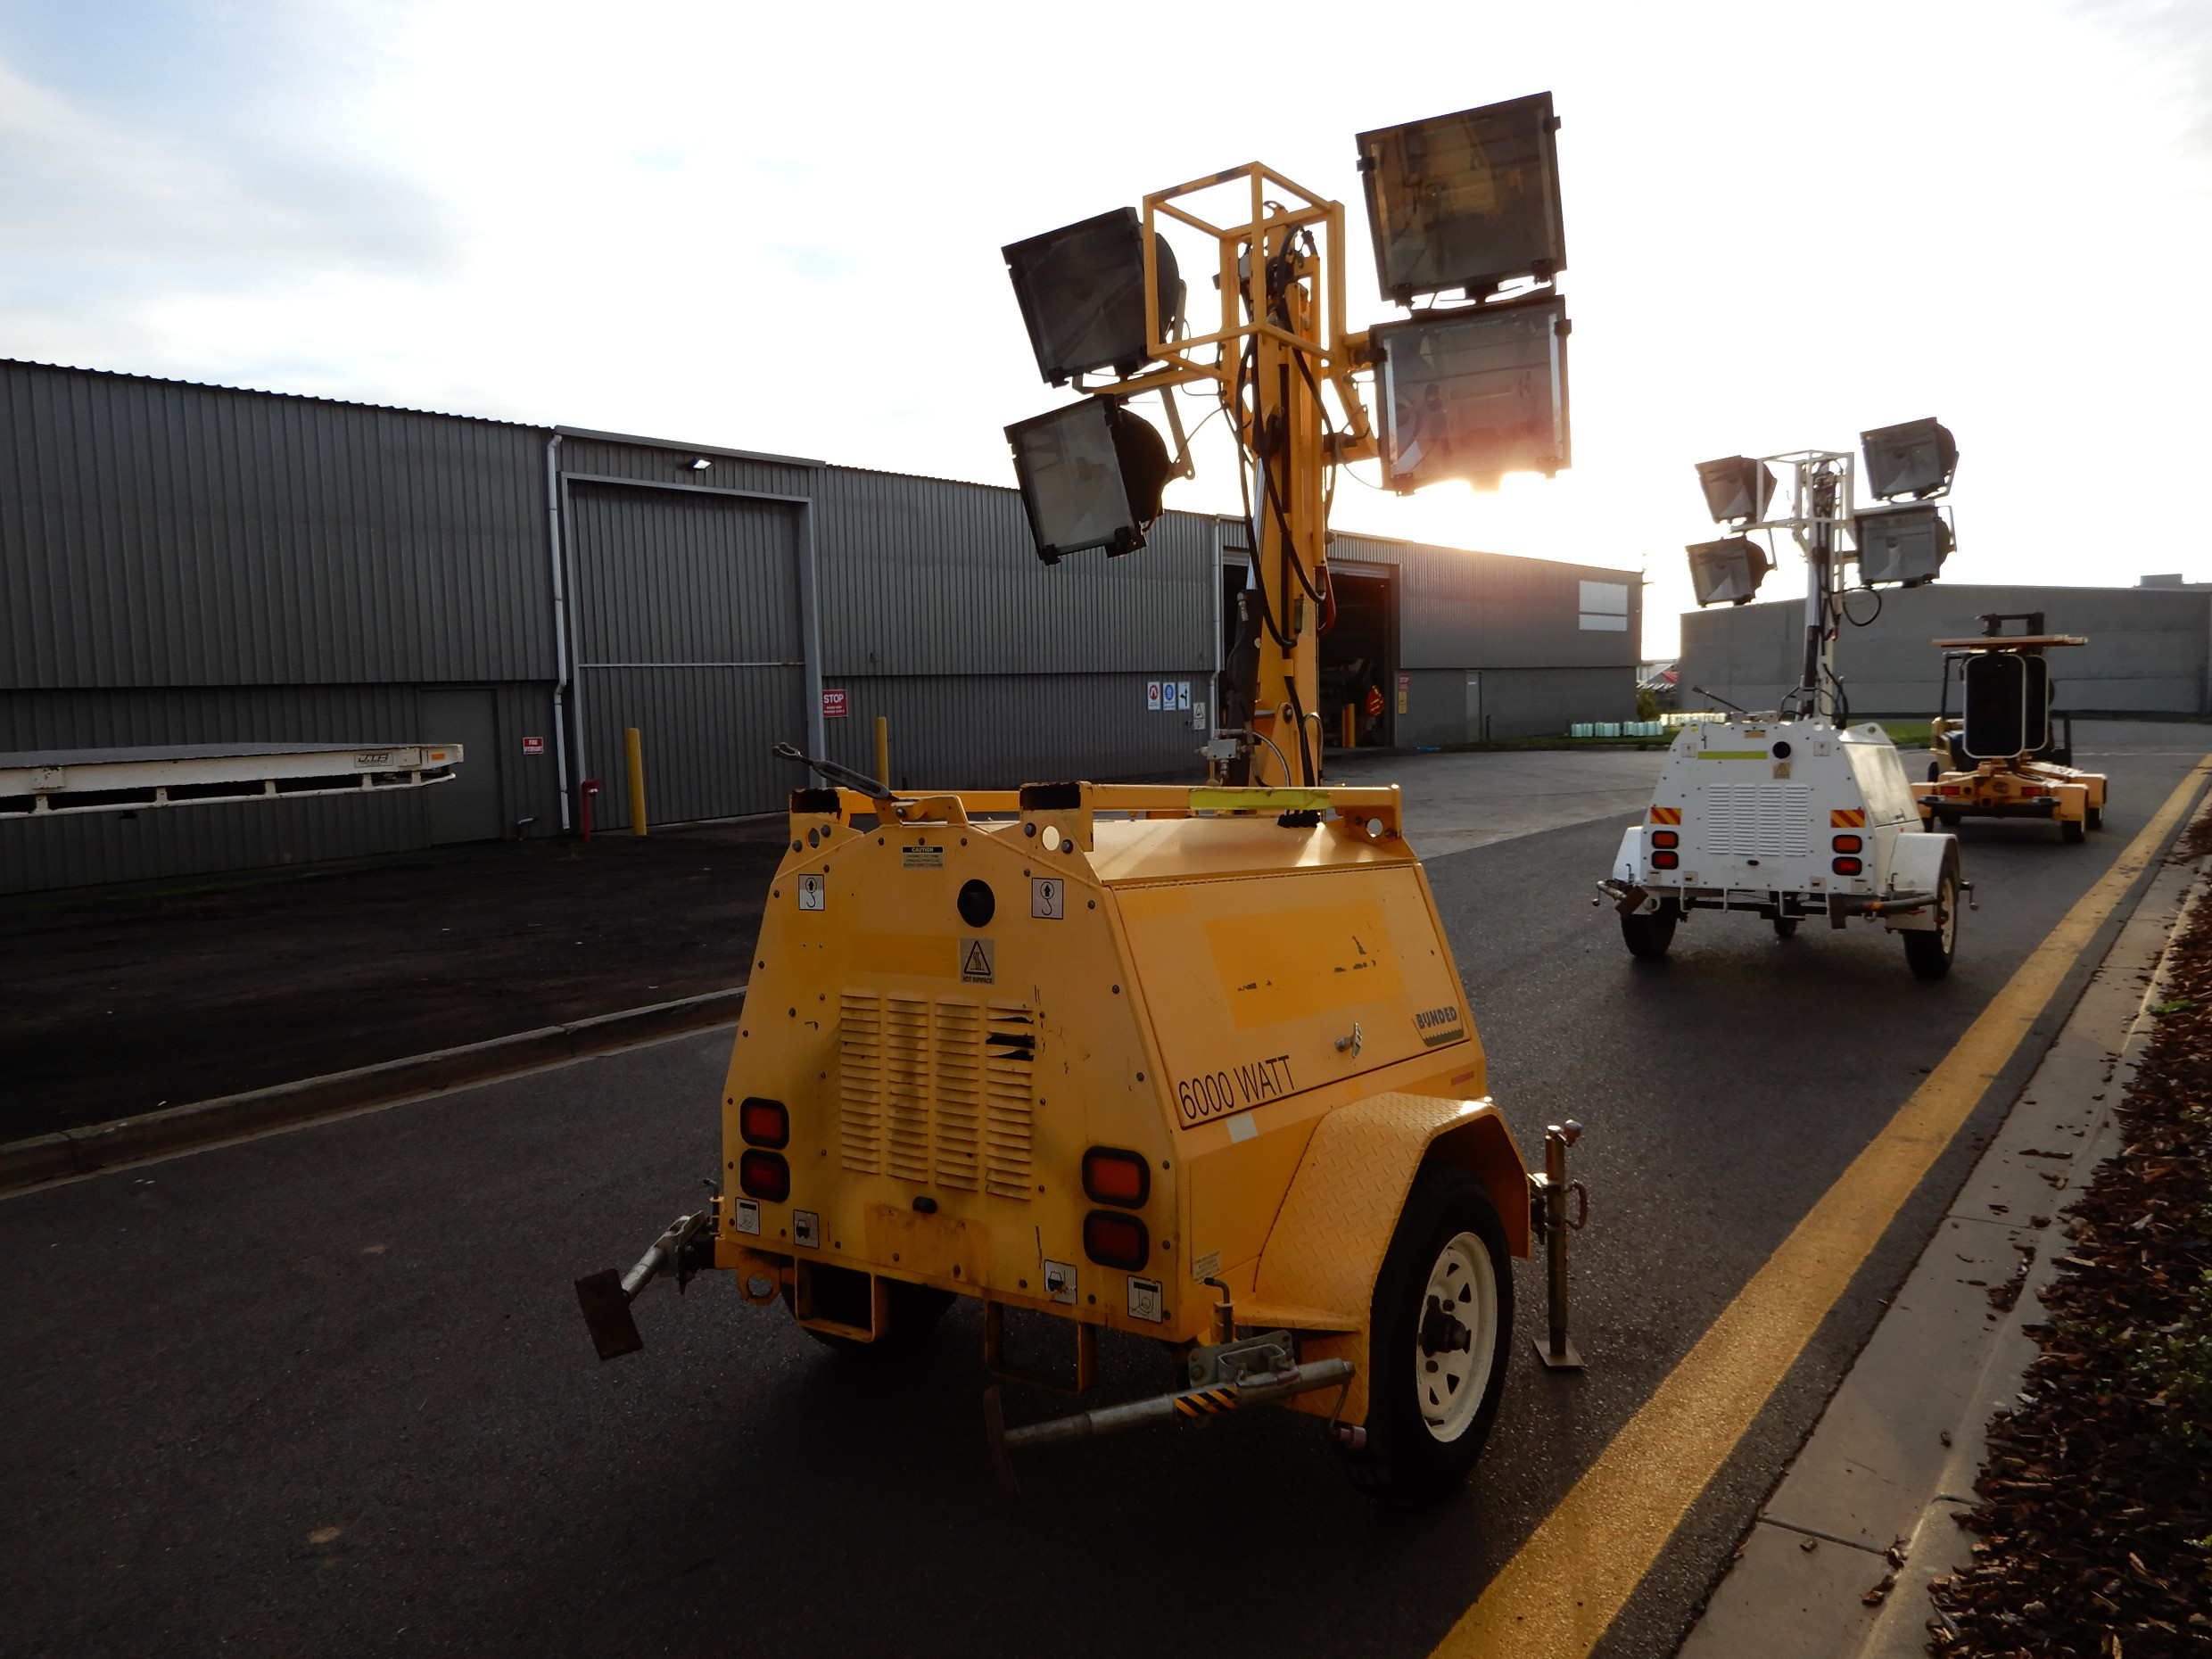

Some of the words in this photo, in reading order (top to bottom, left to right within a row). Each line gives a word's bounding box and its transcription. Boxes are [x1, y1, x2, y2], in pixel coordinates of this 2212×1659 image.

[823, 694, 845, 704] STOP
[1416, 1006, 1457, 1029] BUNDED
[1178, 1071, 1234, 1119] 6000
[1234, 1055, 1294, 1102] WATT
